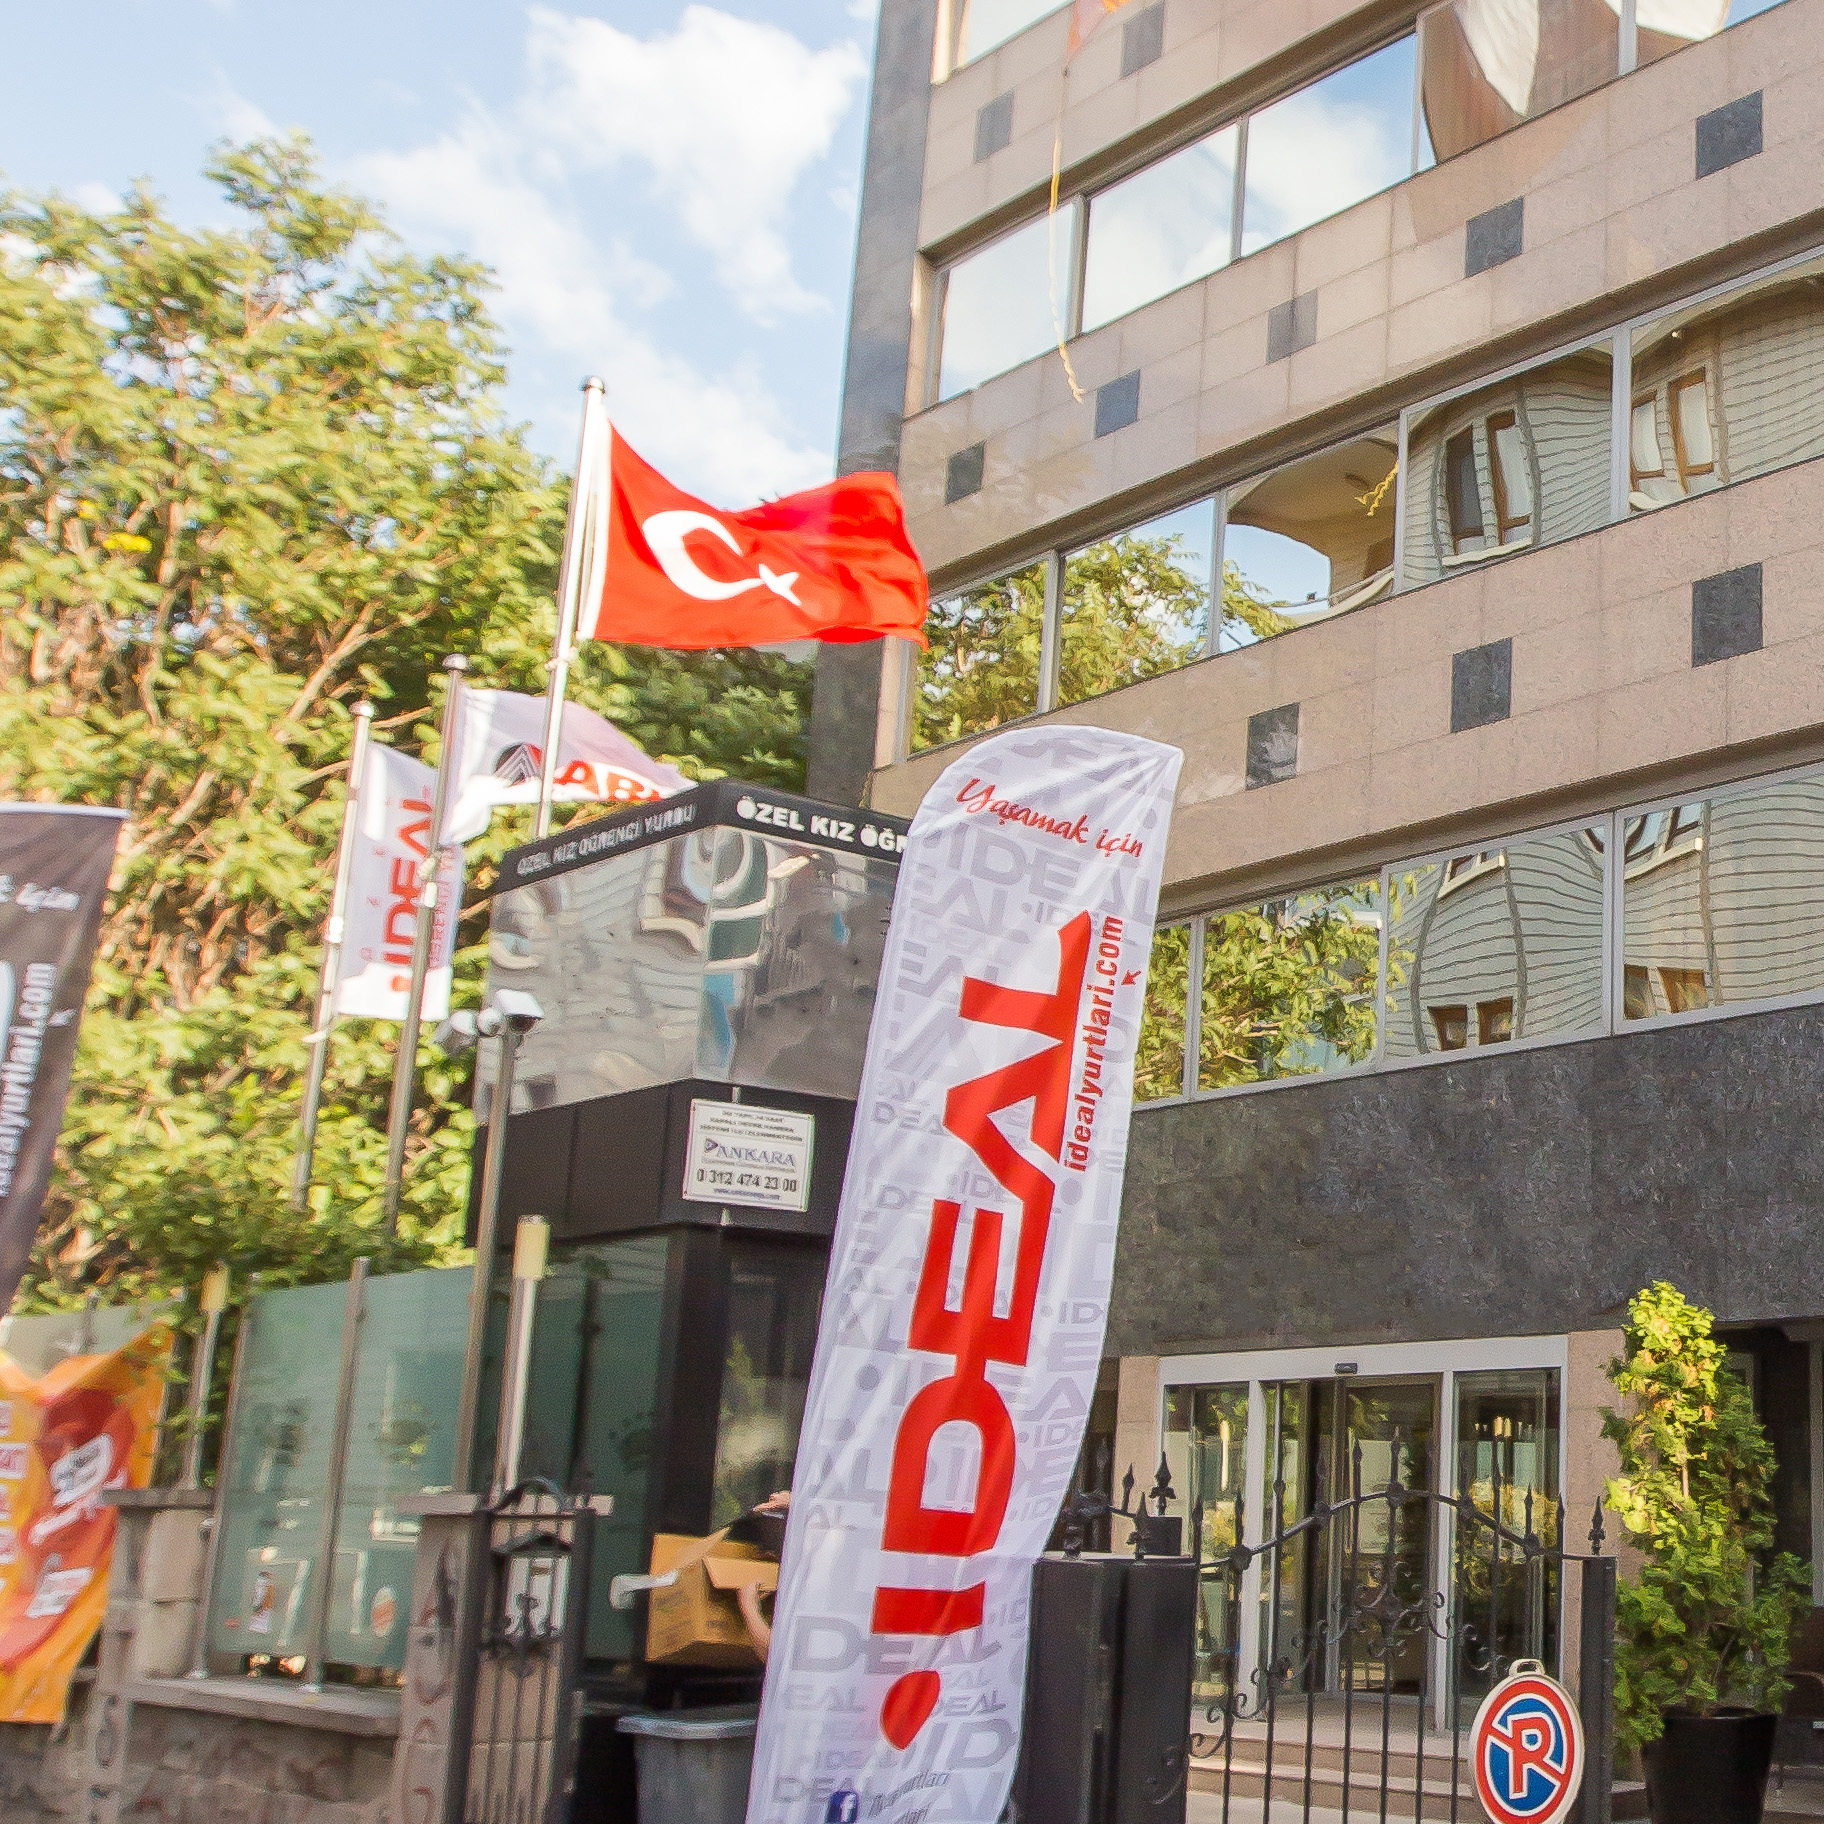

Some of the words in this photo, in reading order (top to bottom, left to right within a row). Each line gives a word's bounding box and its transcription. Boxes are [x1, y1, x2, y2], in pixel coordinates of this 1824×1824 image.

[736, 794, 806, 832] ÖZEL
[810, 814, 856, 843] KIZ
[955, 776, 1090, 845] Yaşamak
[1095, 826, 1145, 859] için
[1063, 914, 1124, 1173] idealyurtlari.com
[716, 1144, 796, 1167] ANKARA
[870, 909, 1092, 1636] IDEAL
